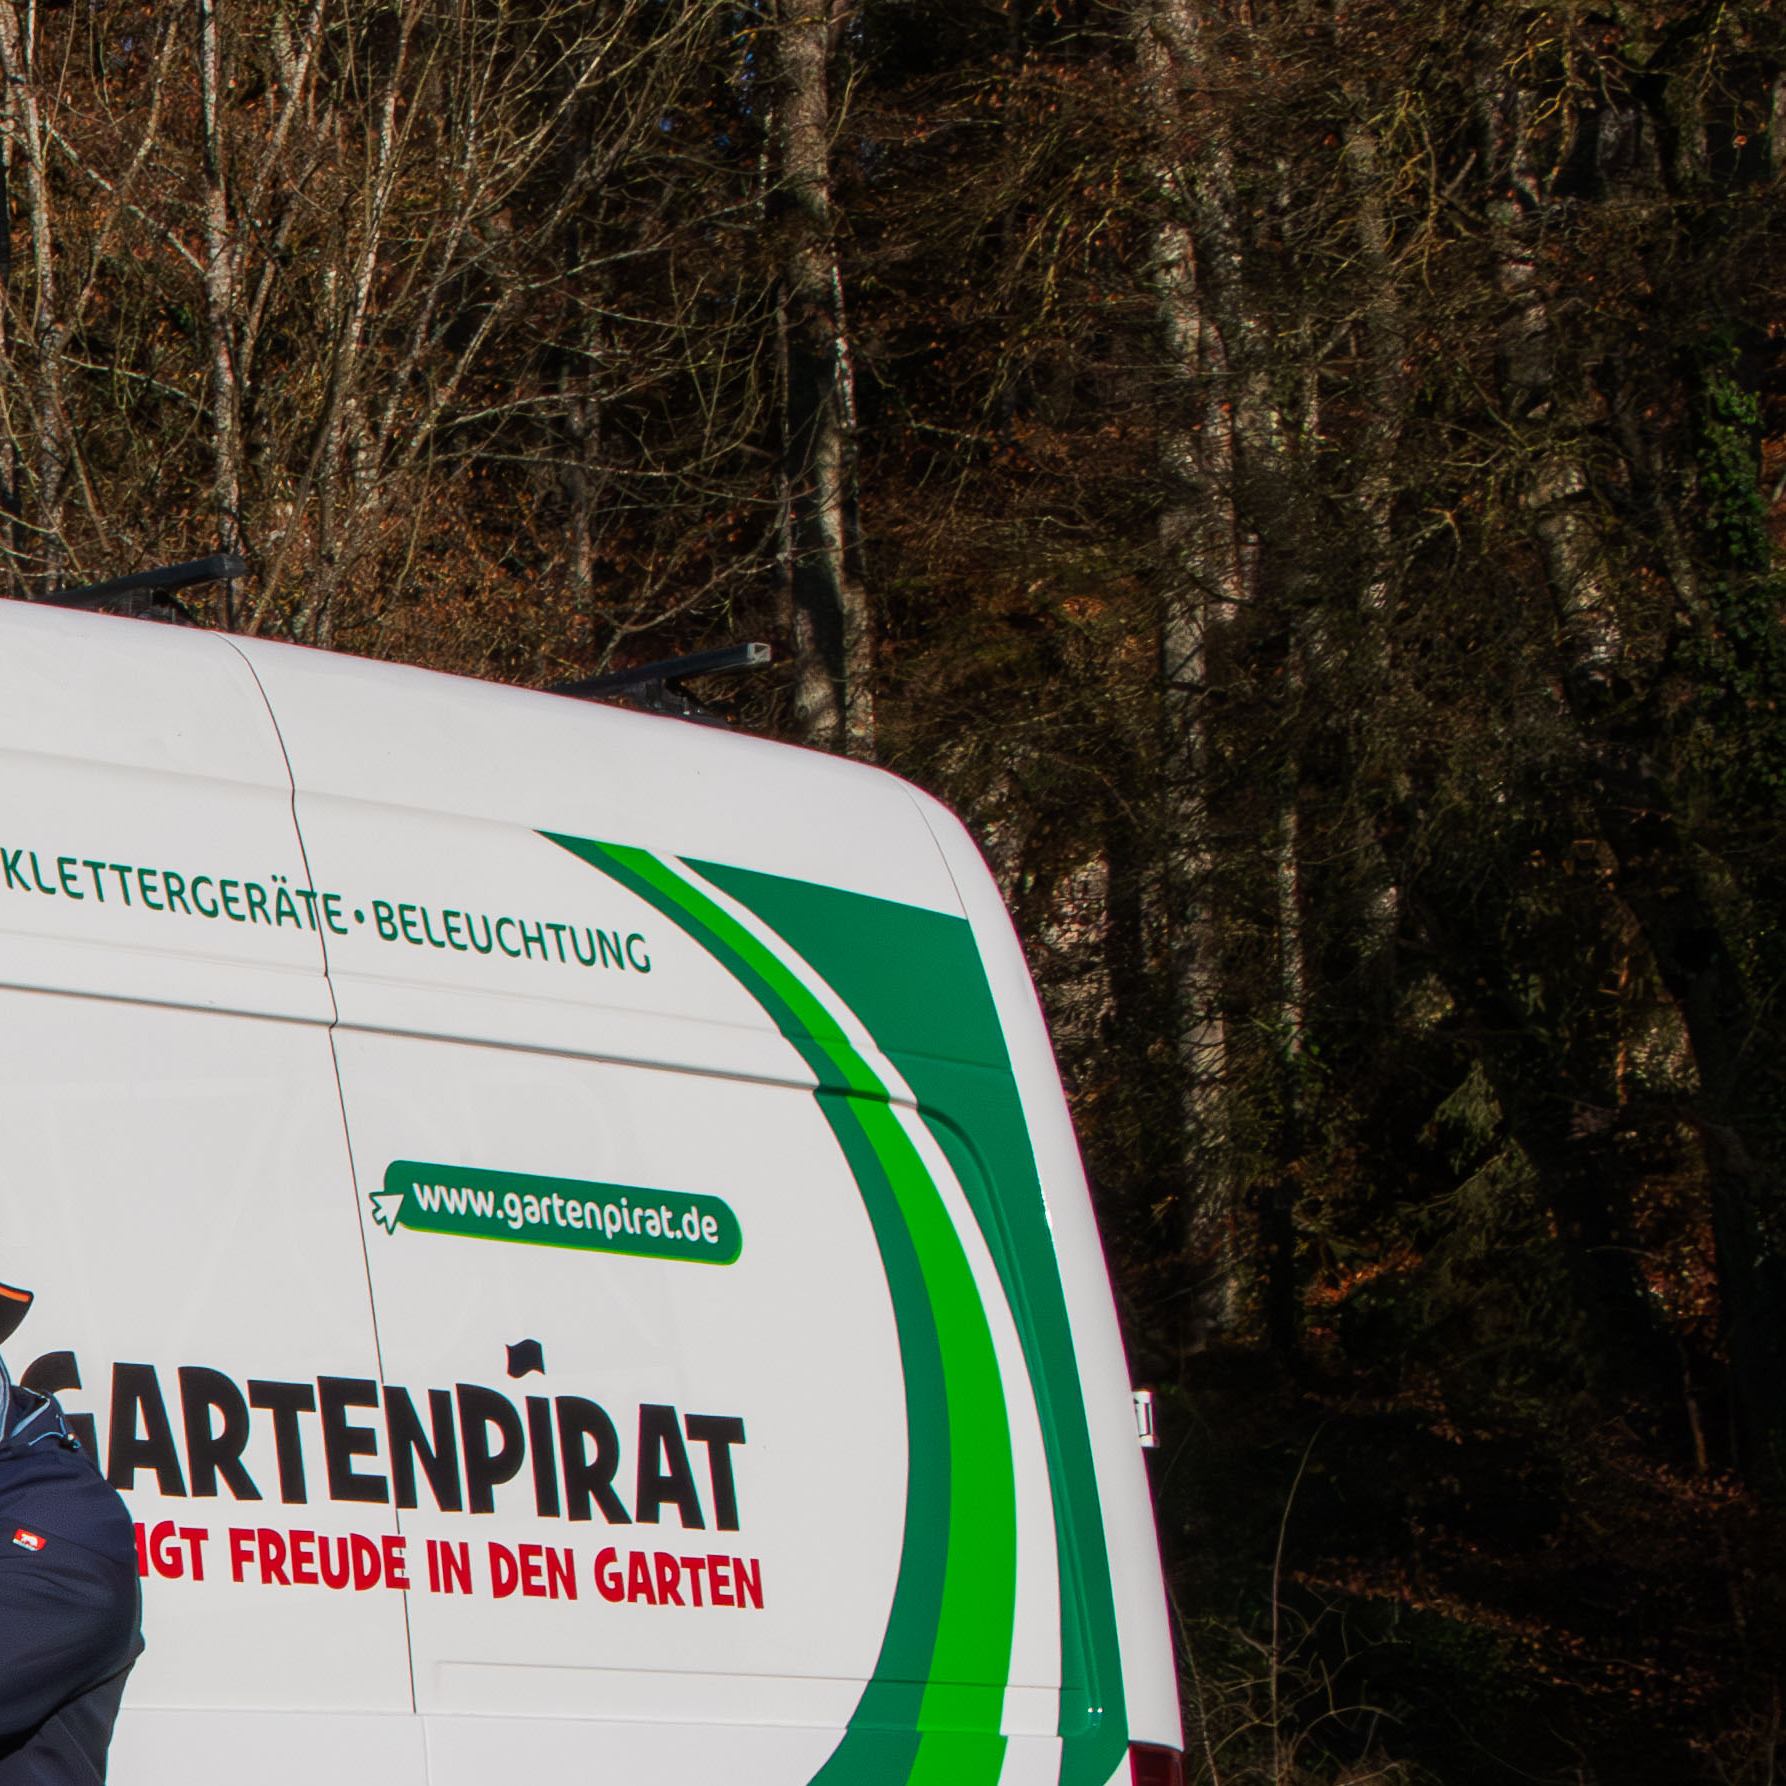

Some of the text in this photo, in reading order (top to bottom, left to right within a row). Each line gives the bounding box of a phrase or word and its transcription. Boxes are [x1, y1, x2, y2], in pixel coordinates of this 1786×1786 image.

[372, 899, 652, 974] BELEUCHTUNG
[412, 1182, 720, 1244] www.gartenpirat.de
[228, 1527, 411, 1592] FREUDE
[425, 1538, 473, 1595] IN
[487, 1541, 578, 1601] DEN
[593, 1546, 765, 1610] GARTEN
